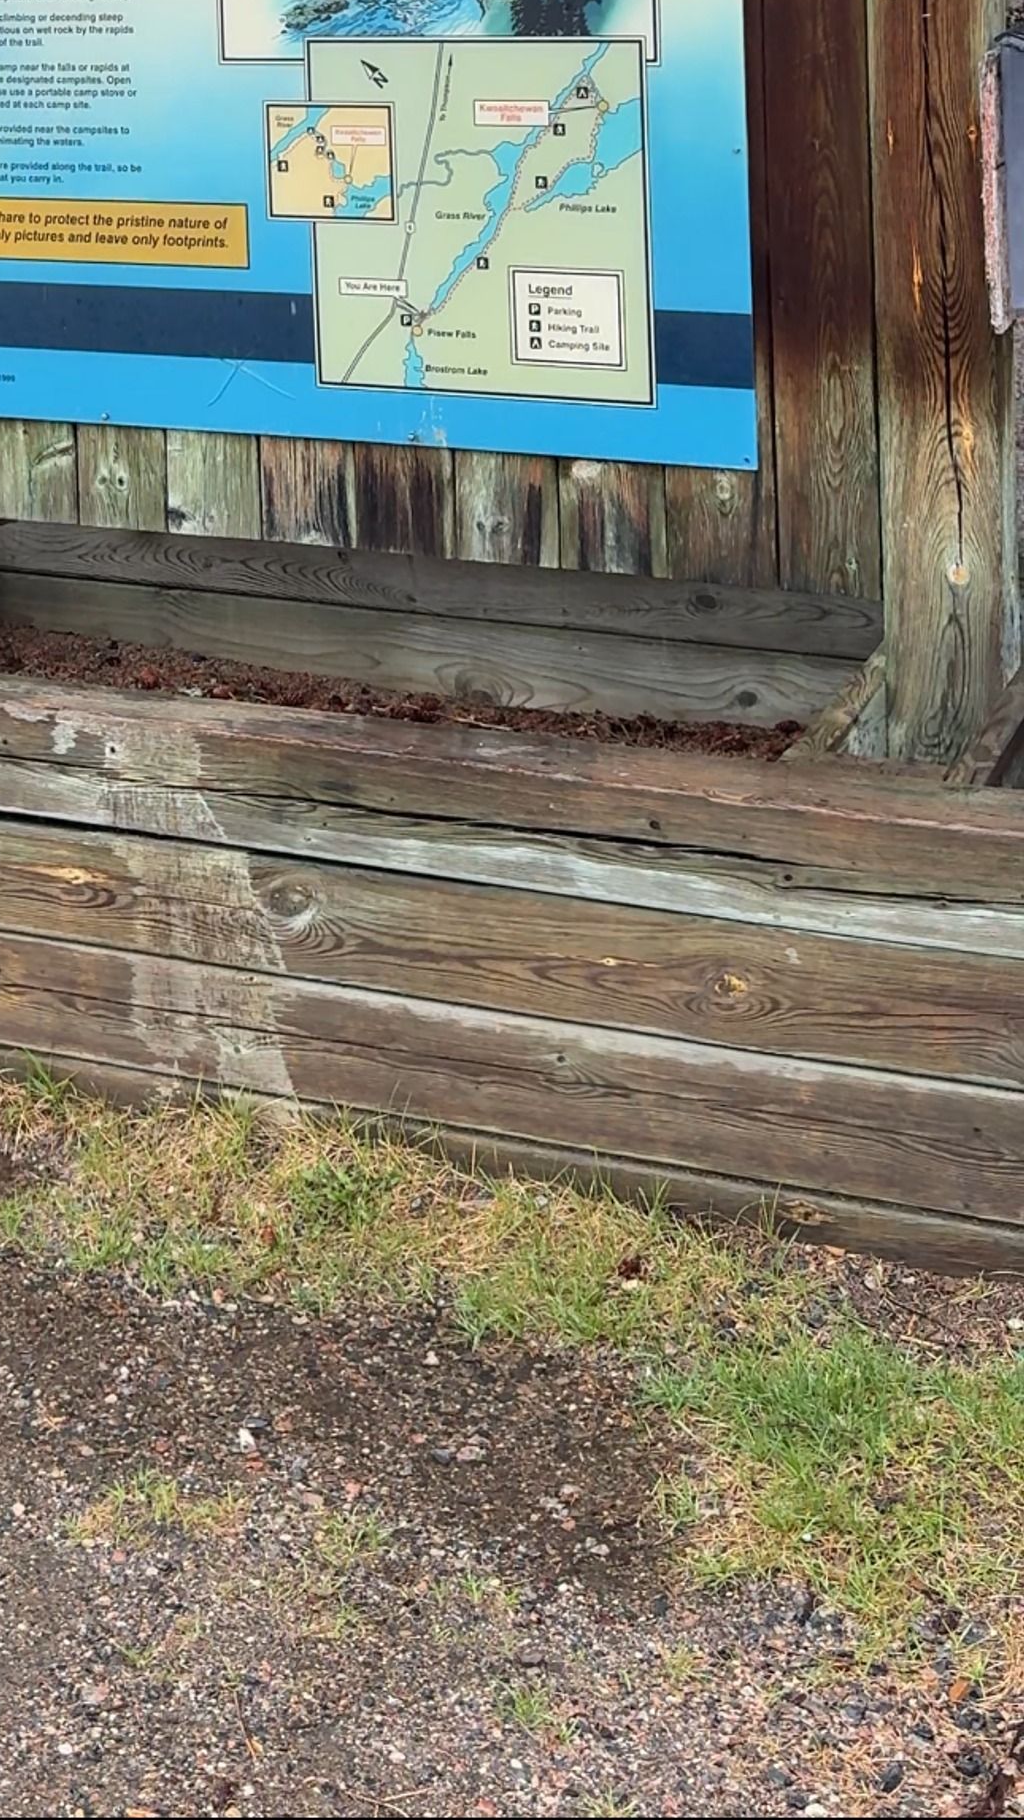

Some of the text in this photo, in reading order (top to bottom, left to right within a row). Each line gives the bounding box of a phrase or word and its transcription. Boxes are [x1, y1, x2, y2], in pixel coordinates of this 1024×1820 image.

[373, 71, 389, 88] N
[558, 202, 617, 214] Phillips Lake
[28, 212, 41, 224] to
[43, 213, 89, 227] protect
[92, 213, 113, 226] the
[115, 214, 165, 230] pristine
[167, 216, 210, 229] nature
[213, 216, 228, 230] of
[434, 210, 487, 221] Grass River
[13, 229, 64, 244] pictures
[67, 230, 92, 243] and
[94, 231, 128, 245] leave
[131, 233, 160, 249] only
[162, 233, 228, 250] footprints.
[344, 282, 400, 292] You Are Here
[527, 283, 572, 298] Legend
[547, 306, 582, 318] Parking
[427, 328, 476, 339] Pisew Falls
[547, 323, 599, 335] Hiking Trail
[547, 339, 610, 352] Camping Site
[425, 365, 488, 376] Brostrom Lake
